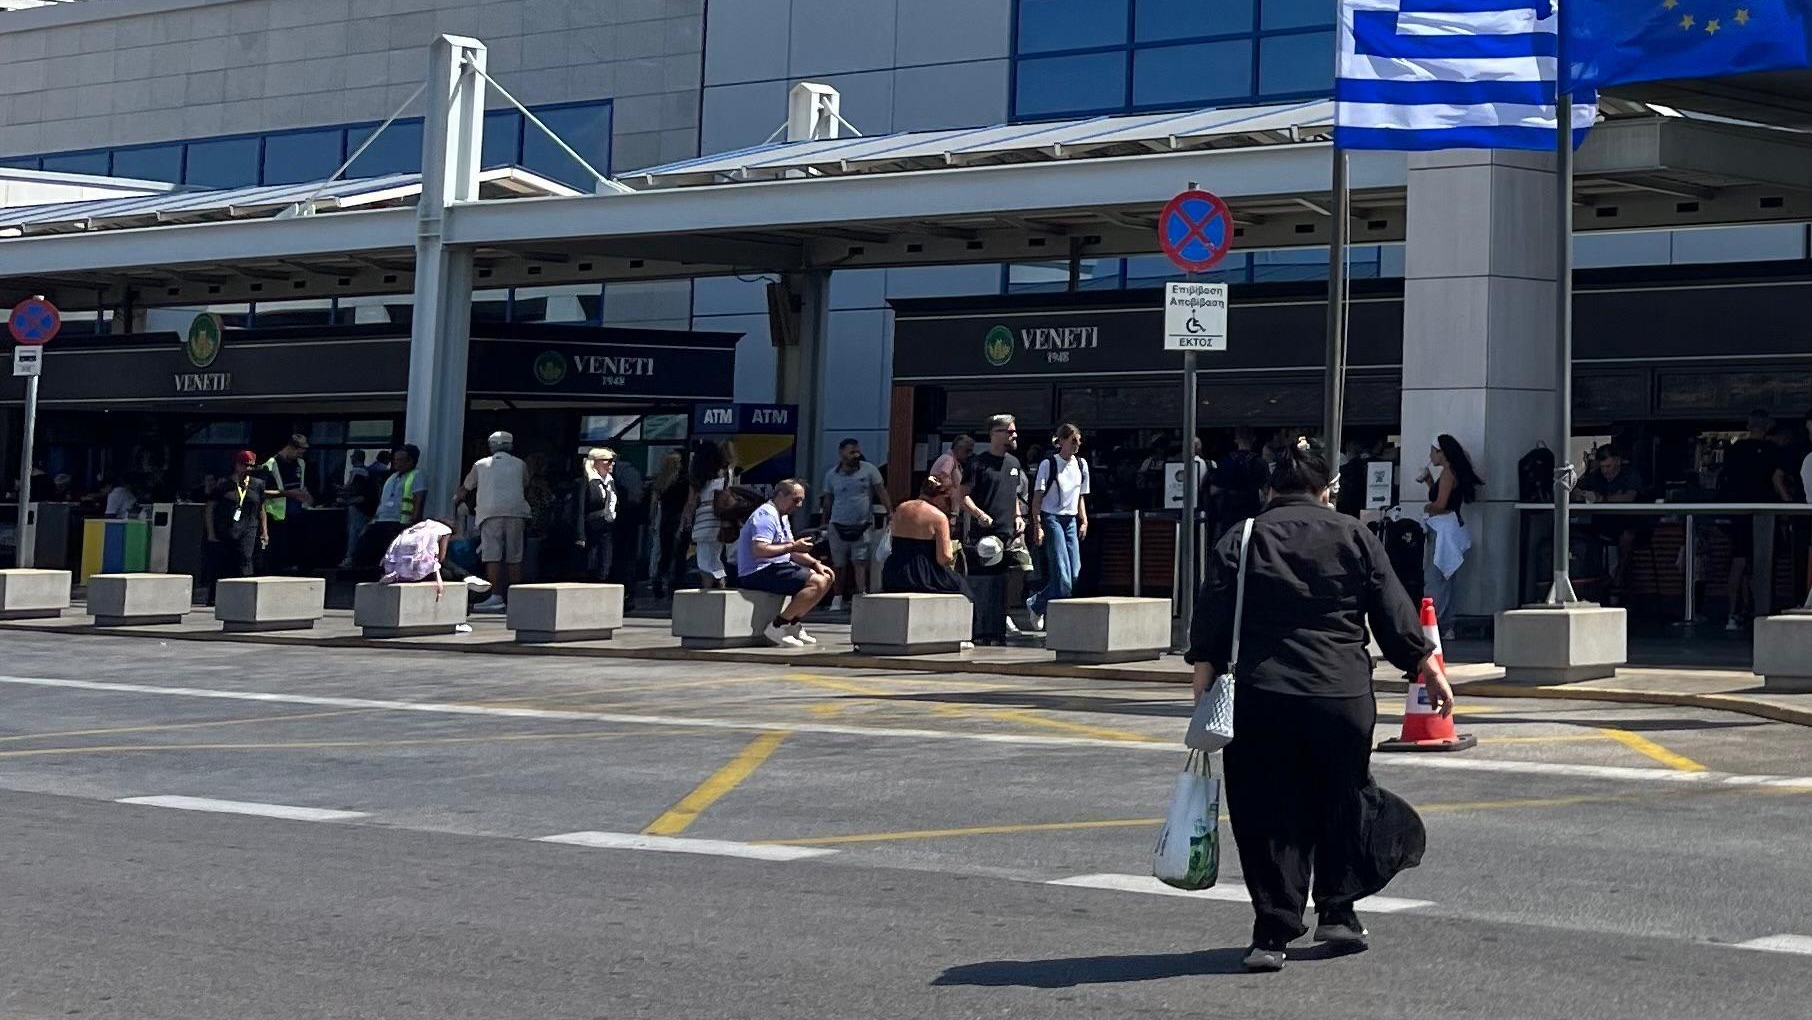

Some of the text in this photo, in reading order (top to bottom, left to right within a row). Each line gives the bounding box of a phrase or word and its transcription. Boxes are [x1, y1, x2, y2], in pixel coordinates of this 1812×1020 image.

[1021, 326, 1099, 350] VENETI
[573, 356, 654, 375] VENETI
[703, 409, 733, 424] ATM
[752, 409, 788, 424] ATM
